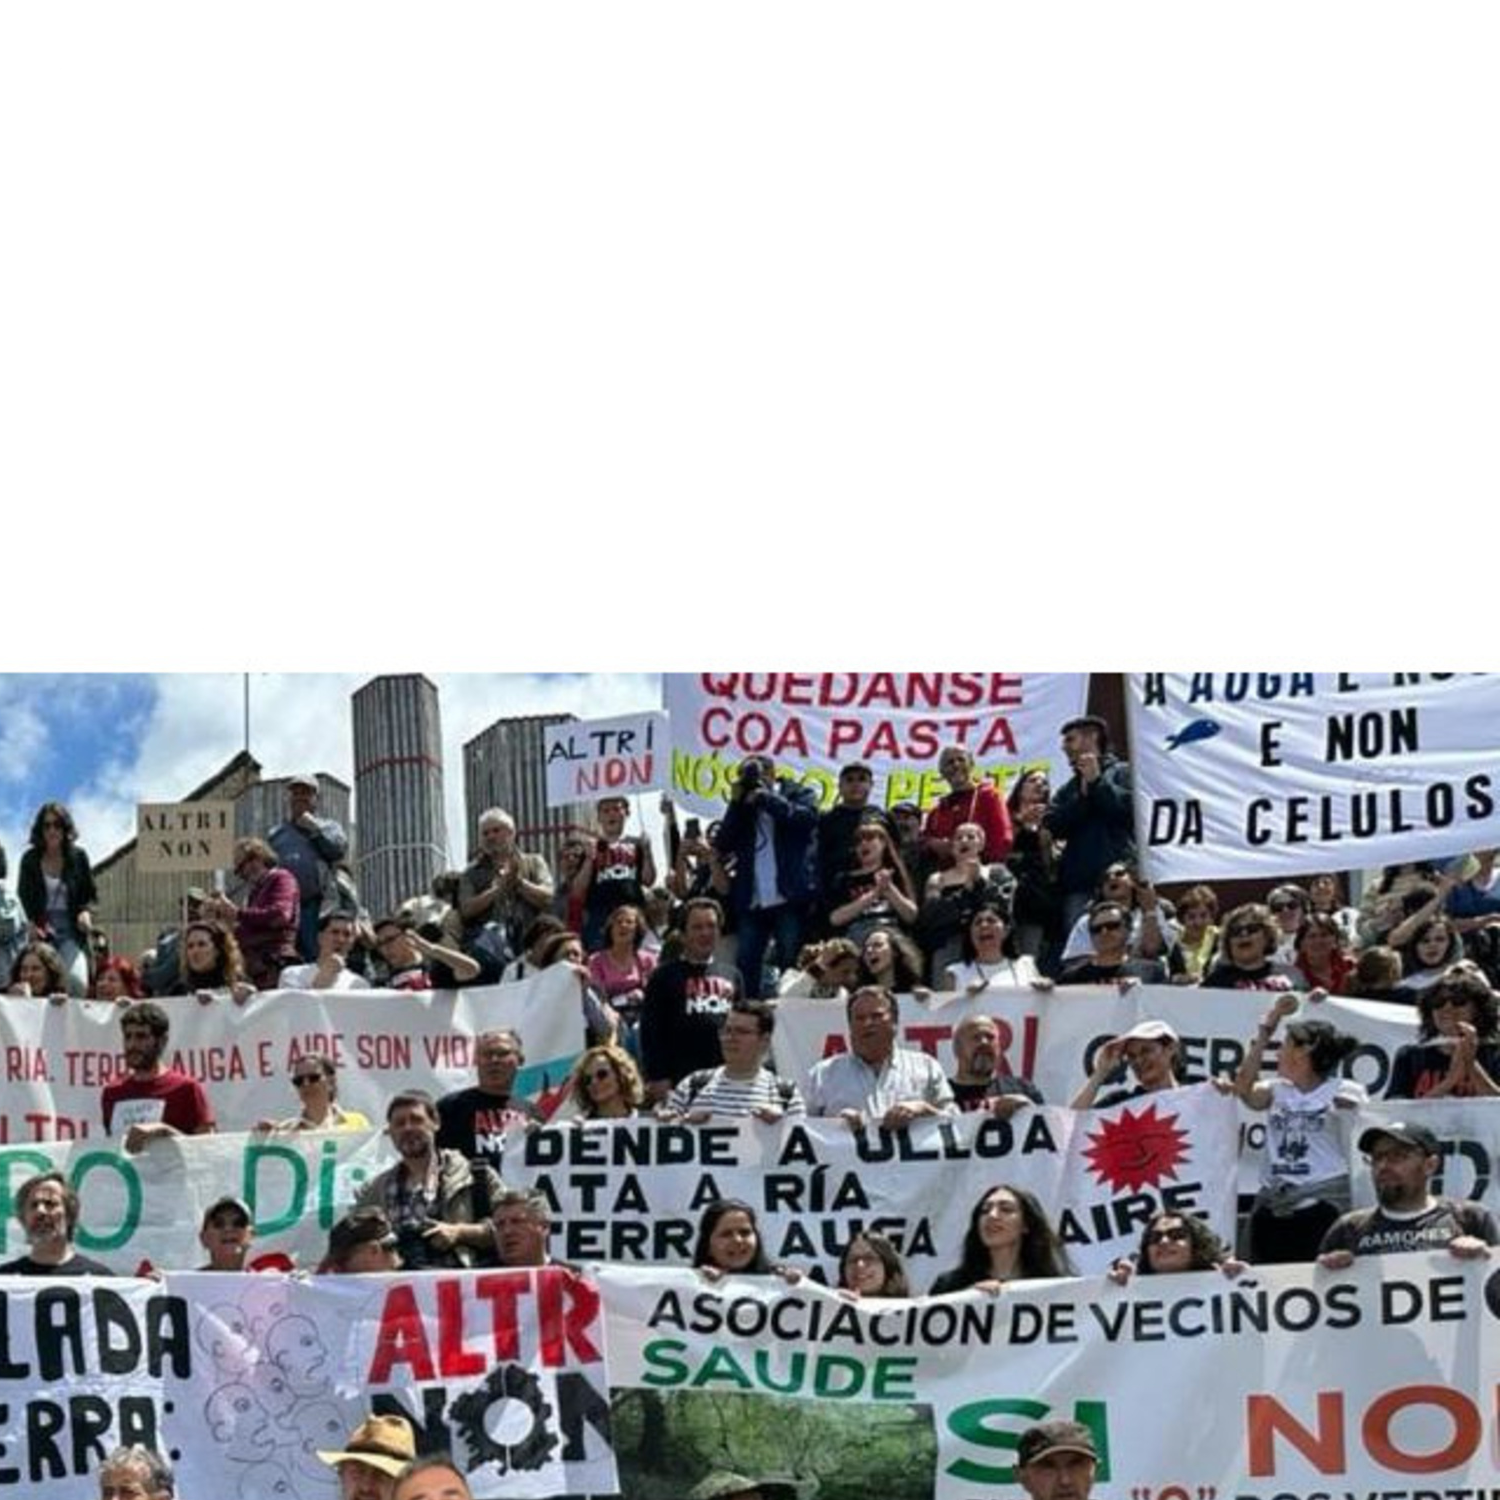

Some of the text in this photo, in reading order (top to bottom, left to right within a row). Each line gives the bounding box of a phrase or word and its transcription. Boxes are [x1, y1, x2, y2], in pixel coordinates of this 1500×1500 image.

[548, 719, 653, 765] ALTRI
[701, 707, 1019, 760] COA PASTA
[1260, 706, 1420, 768] E NON
[576, 753, 653, 796] NON
[141, 809, 226, 831] ALTRI
[1147, 799, 1204, 847] DA
[158, 840, 212, 858] NON
[258, 1042, 274, 1078] E
[357, 1033, 412, 1070] SON
[524, 1126, 740, 1167] DENDE
[778, 1126, 818, 1166] A
[763, 1164, 871, 1214] RÍA
[1007, 1301, 1079, 1346] DE
[1089, 1279, 1363, 1345] VECIÑOS
[1380, 1276, 1468, 1327] DE
[640, 1339, 919, 1401] SAUDE
[1246, 1383, 1500, 1479] NO
